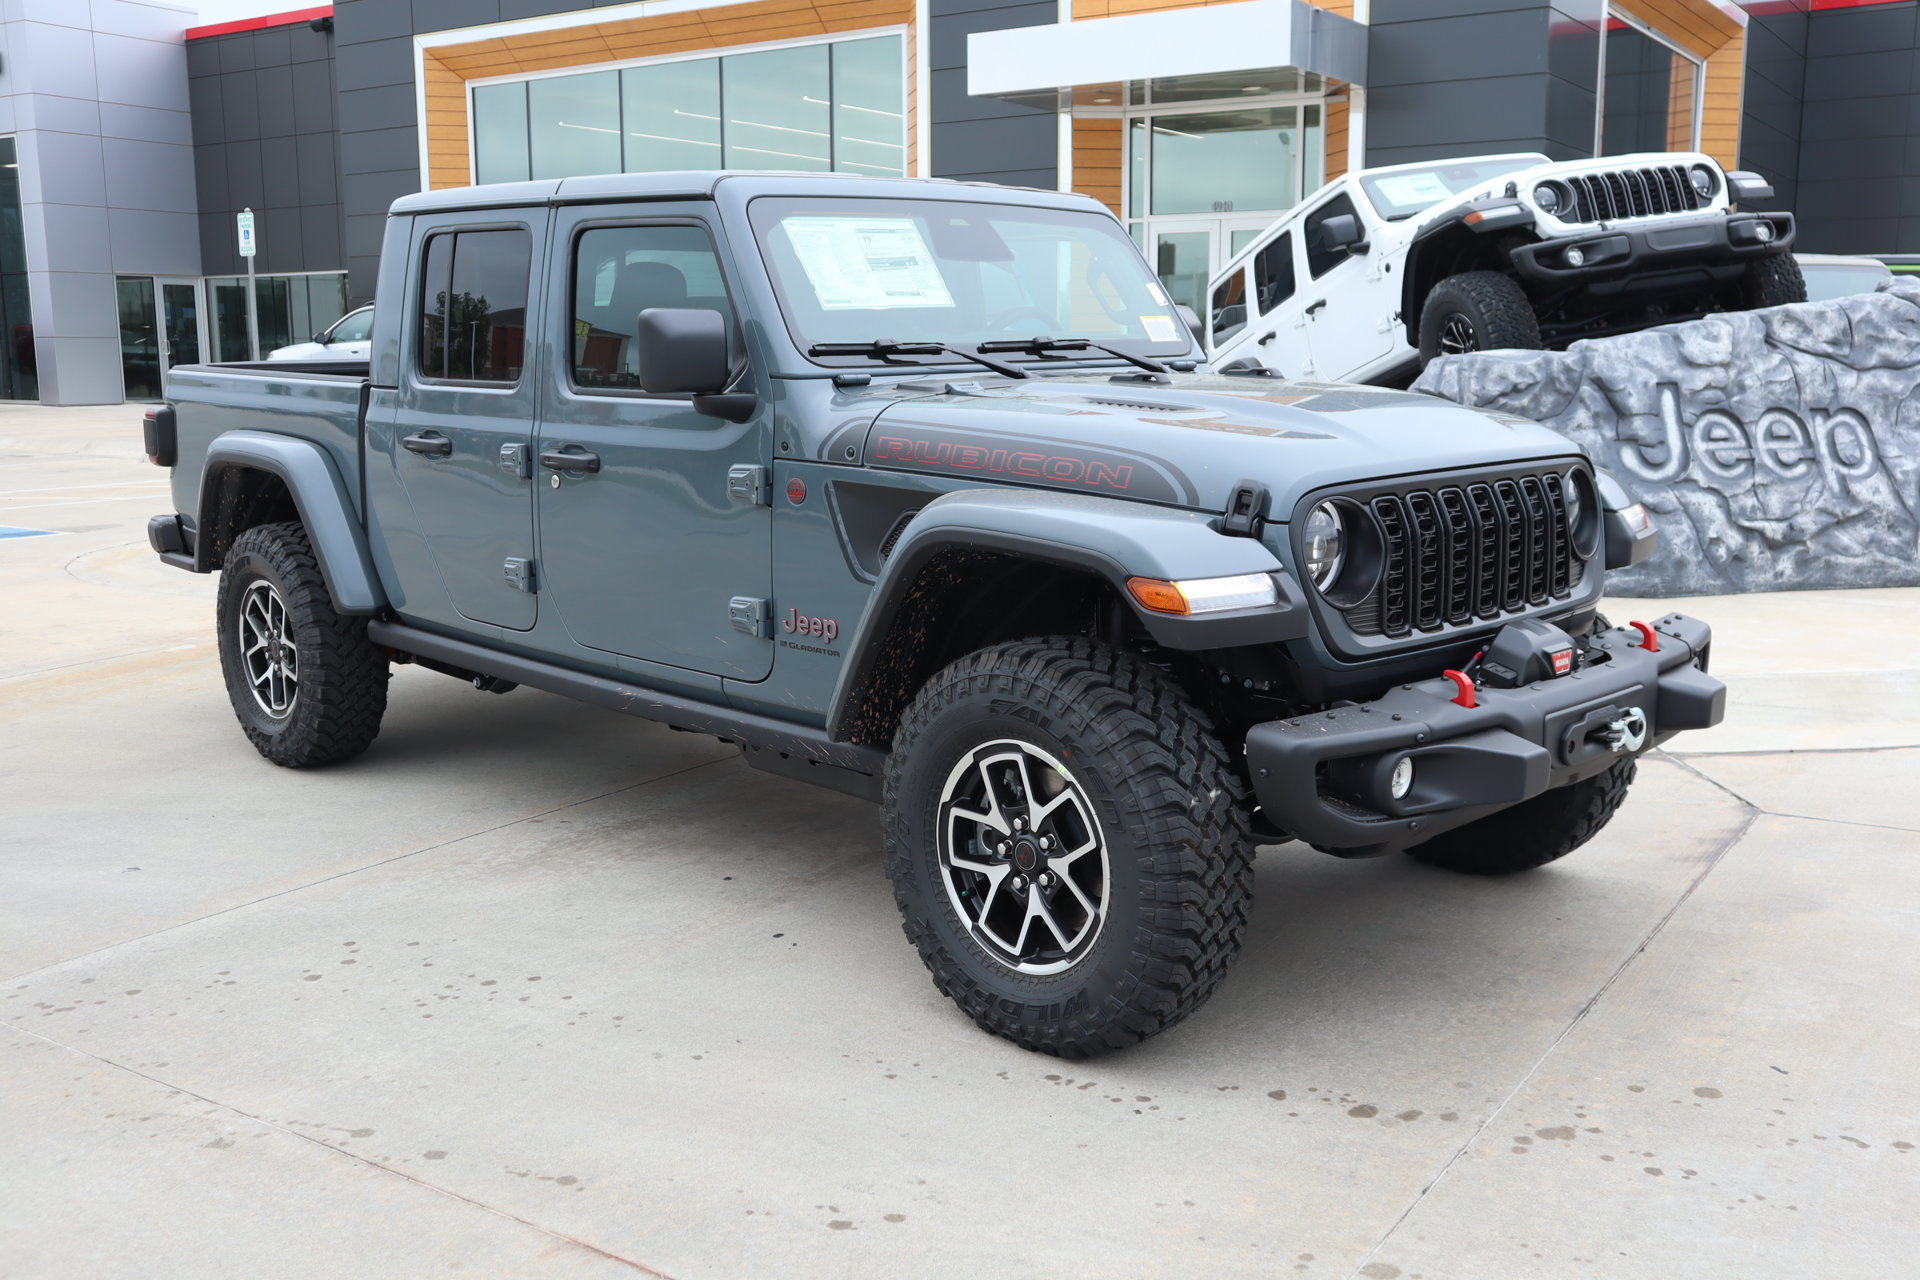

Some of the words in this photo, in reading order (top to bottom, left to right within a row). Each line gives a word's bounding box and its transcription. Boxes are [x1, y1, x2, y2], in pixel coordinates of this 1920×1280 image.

[875, 436, 1134, 489] RUBICON
[1614, 382, 1881, 500] Jeep
[781, 607, 839, 645] Jeep
[788, 642, 841, 658] GLADIATOR
[989, 698, 1126, 834] FALKEN
